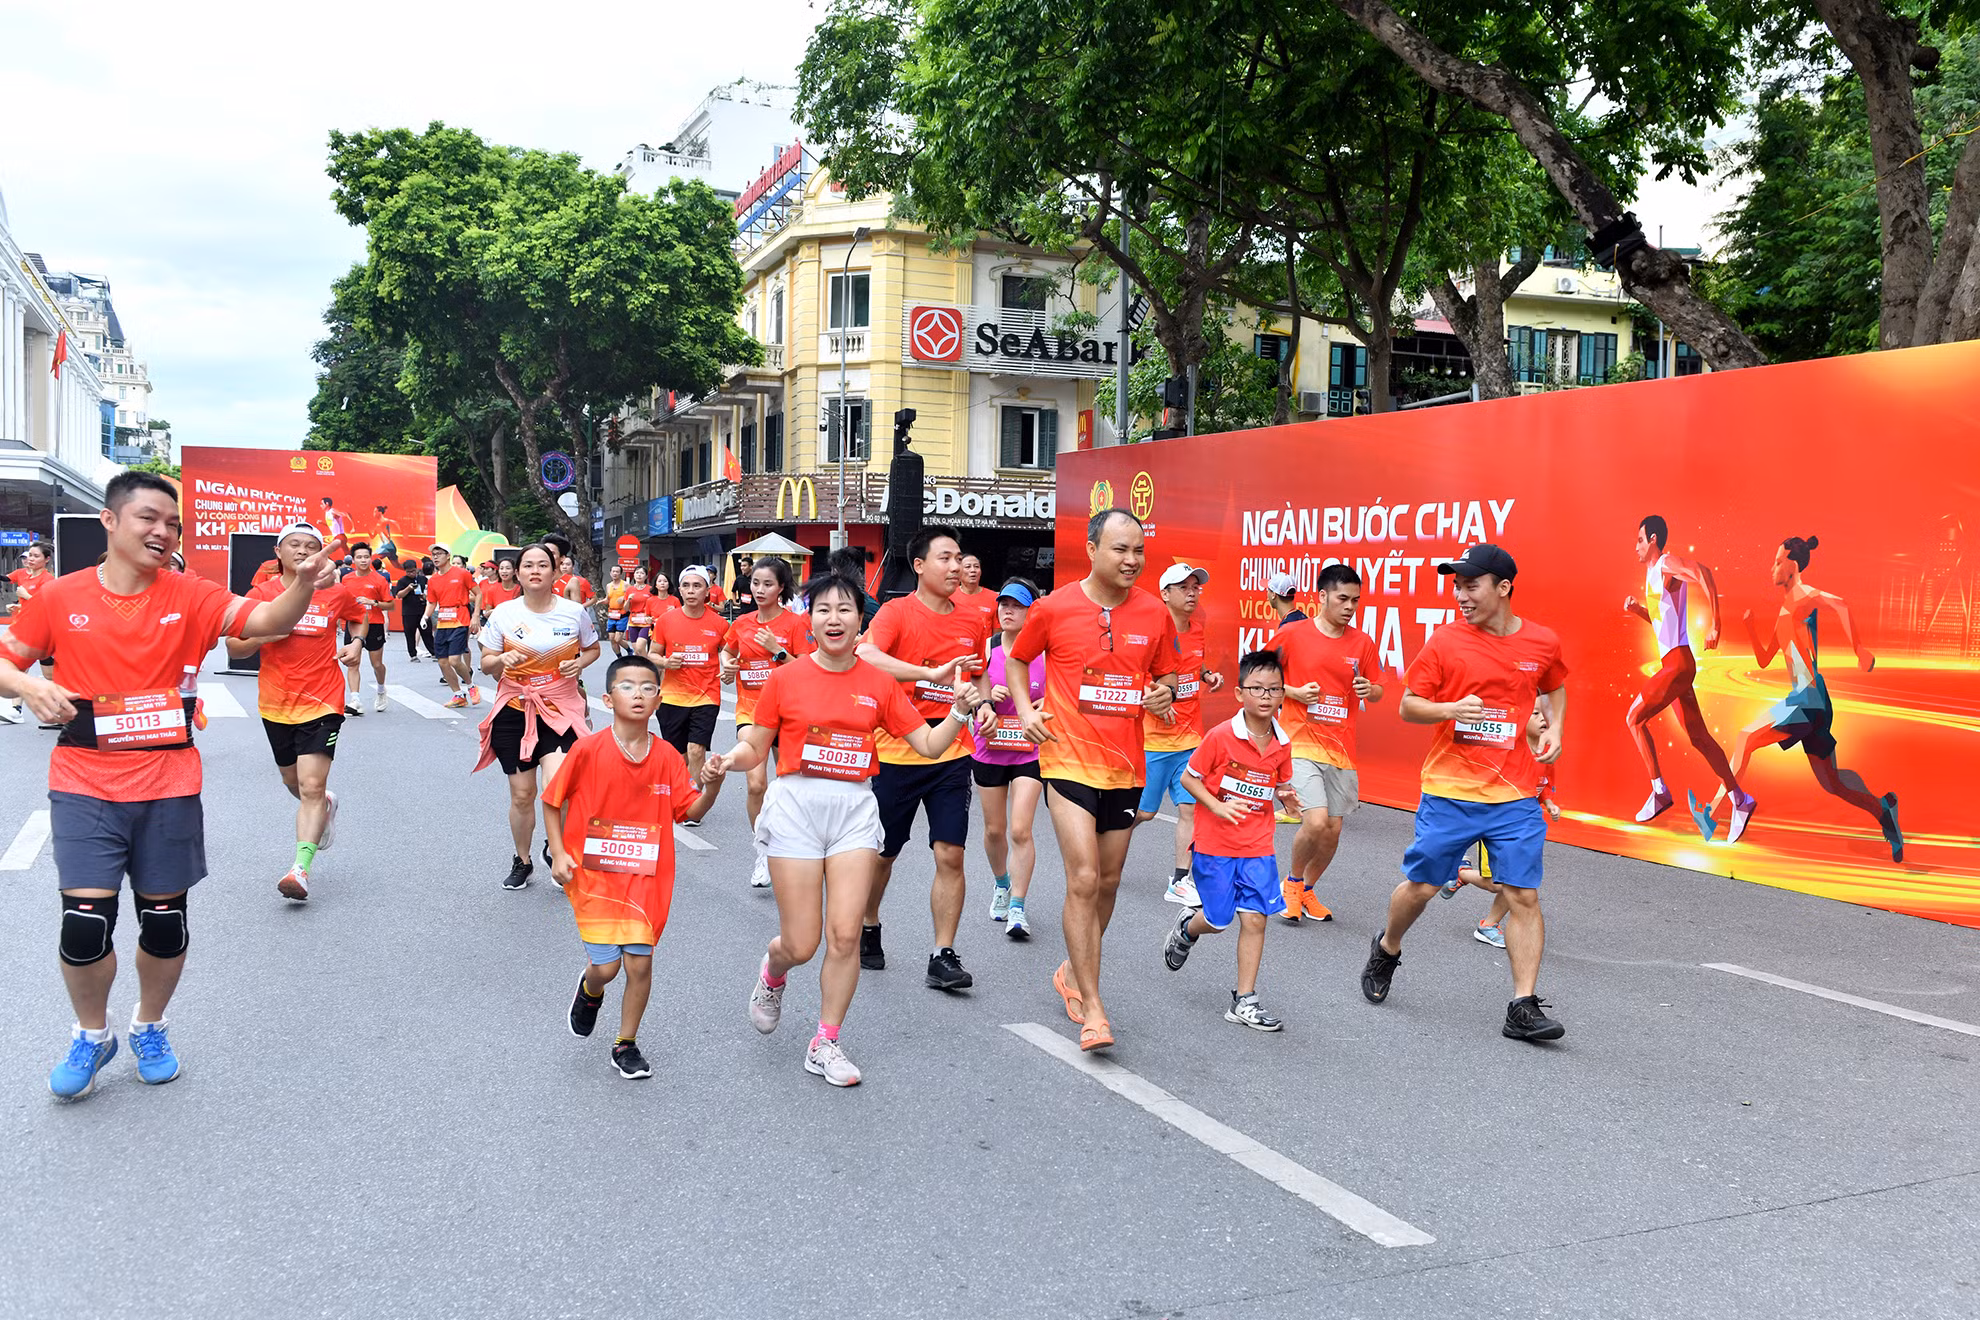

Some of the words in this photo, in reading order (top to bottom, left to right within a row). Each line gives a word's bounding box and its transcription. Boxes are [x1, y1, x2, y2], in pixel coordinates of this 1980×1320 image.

[195, 479, 248, 498] NGÀN
[195, 499, 223, 510] CHUNG
[223, 503, 238, 512] MỘT
[240, 501, 284, 513] QUYẾT
[880, 484, 1056, 520] cDonald
[195, 511, 207, 520] VÌ
[209, 511, 237, 521] CỘNG
[237, 511, 260, 521] ĐỒNG
[261, 514, 284, 531] MA
[1241, 502, 1318, 546] NGÀN
[1322, 497, 1410, 545] BƯỚC
[1414, 498, 1515, 546] CHẠY
[1290, 552, 1321, 597] MỘT
[1240, 596, 1253, 619] VÌ
[1095, 689, 1127, 702] 51222
[1178, 684, 1193, 692] 0559
[1317, 705, 1341, 716] 50734
[116, 714, 161, 730] 50113
[1470, 722, 1502, 733] 10555
[108, 734, 135, 744] NGUYỄN
[997, 730, 1023, 740] 10357
[818, 749, 858, 765] 50038
[1236, 782, 1265, 797] 10565
[601, 842, 643, 857] 50093
